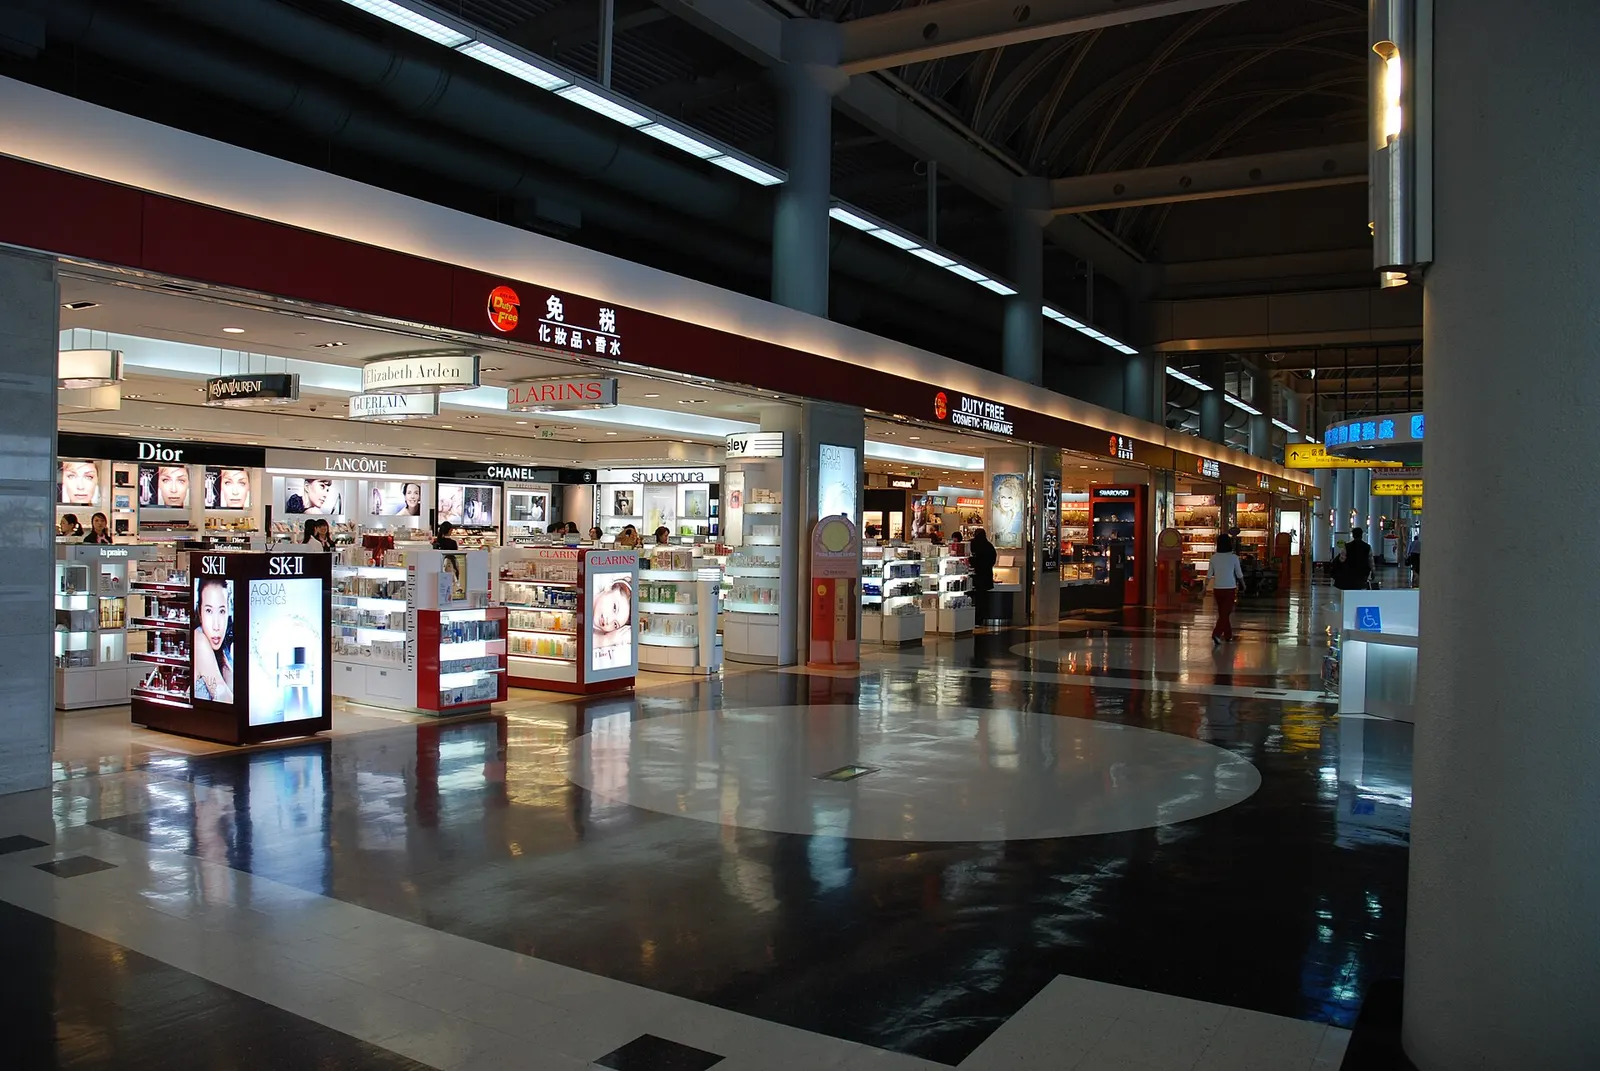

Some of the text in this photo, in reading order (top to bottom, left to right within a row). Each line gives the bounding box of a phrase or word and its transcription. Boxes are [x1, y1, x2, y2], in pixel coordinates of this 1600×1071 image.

[493, 296, 513, 313] Duty
[497, 311, 518, 324] Free
[366, 362, 460, 383] Elizabeth Arden
[508, 382, 603, 404] CLARINS
[353, 394, 407, 411] GUERLAIN
[961, 396, 984, 416] DUTY
[985, 402, 1005, 421] FREE
[138, 442, 184, 462] Dior
[820, 447, 842, 461] AQUA
[325, 456, 388, 473] LANCÔME
[487, 466, 535, 480] CHANEL
[631, 471, 704, 484] shu uemura
[202, 555, 226, 575] SK-II
[269, 556, 304, 575] SK-II
[591, 555, 635, 566] CLARINS
[250, 583, 286, 596] AQUA
[250, 595, 287, 606] PHYSICS
[408, 573, 416, 672] Elizabeth Arden
